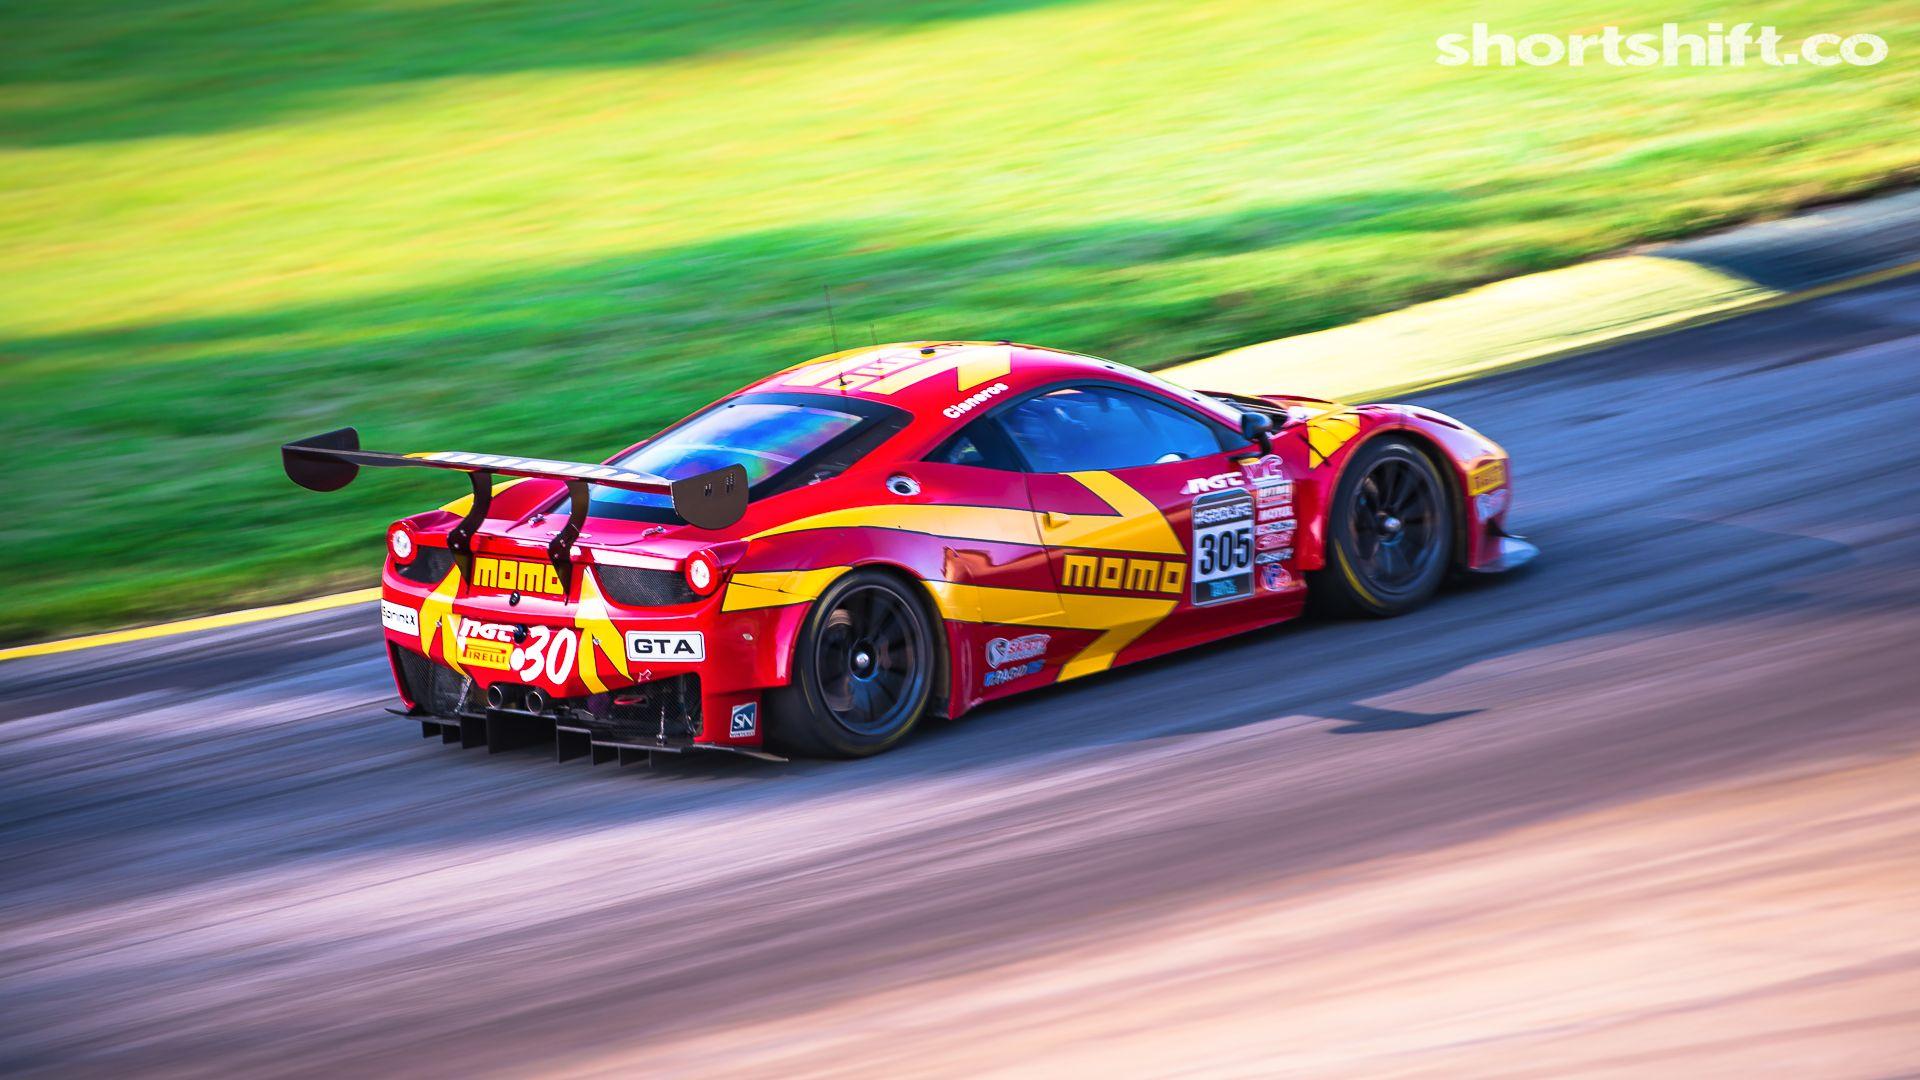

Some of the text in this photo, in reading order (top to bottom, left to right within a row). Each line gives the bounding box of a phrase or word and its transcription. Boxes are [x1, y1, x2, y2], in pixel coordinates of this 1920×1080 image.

[1201, 528, 1250, 575] 305
[463, 644, 506, 664] PIRELLI
[520, 625, 578, 685] 30
[634, 638, 695, 655] GTA
[734, 712, 754, 729] SN
